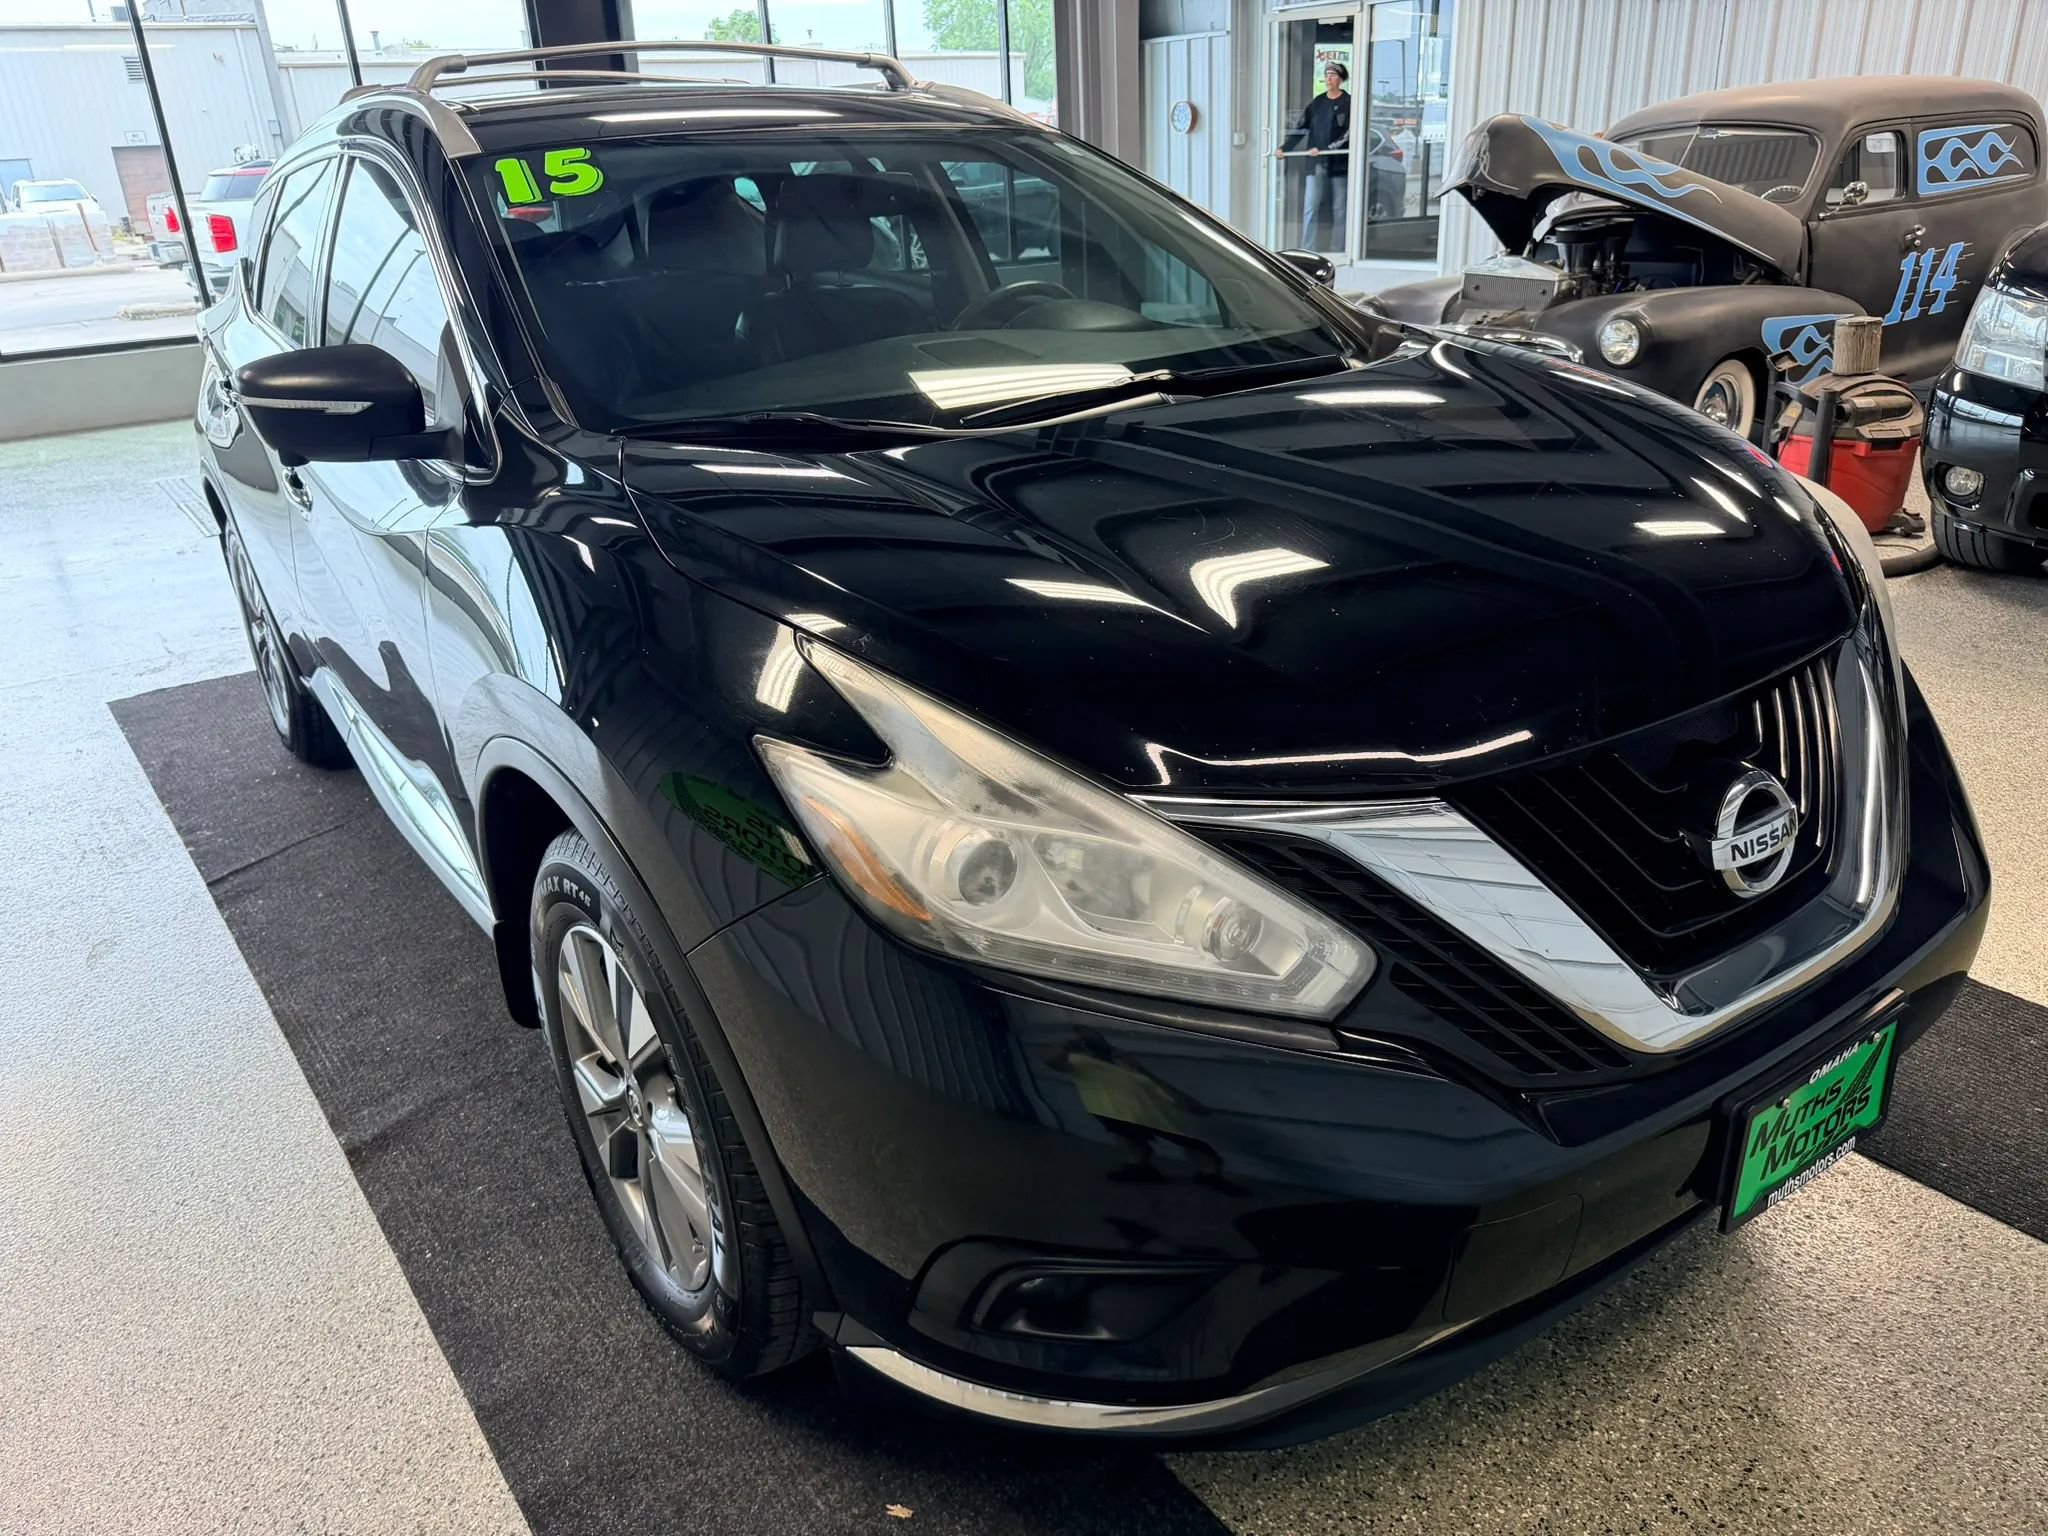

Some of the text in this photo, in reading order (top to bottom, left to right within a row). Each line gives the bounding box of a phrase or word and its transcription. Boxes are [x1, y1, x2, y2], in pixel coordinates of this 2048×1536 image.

[495, 147, 604, 203] 15
[1882, 242, 1965, 326] 114
[1730, 817, 1797, 862] NISSAN
[1808, 1041, 1860, 1085] OMAHA
[1750, 1077, 1846, 1159] MUTHS
[1760, 1084, 1873, 1181] MOTORS
[1766, 1135, 1857, 1208] muthsmotors.com
